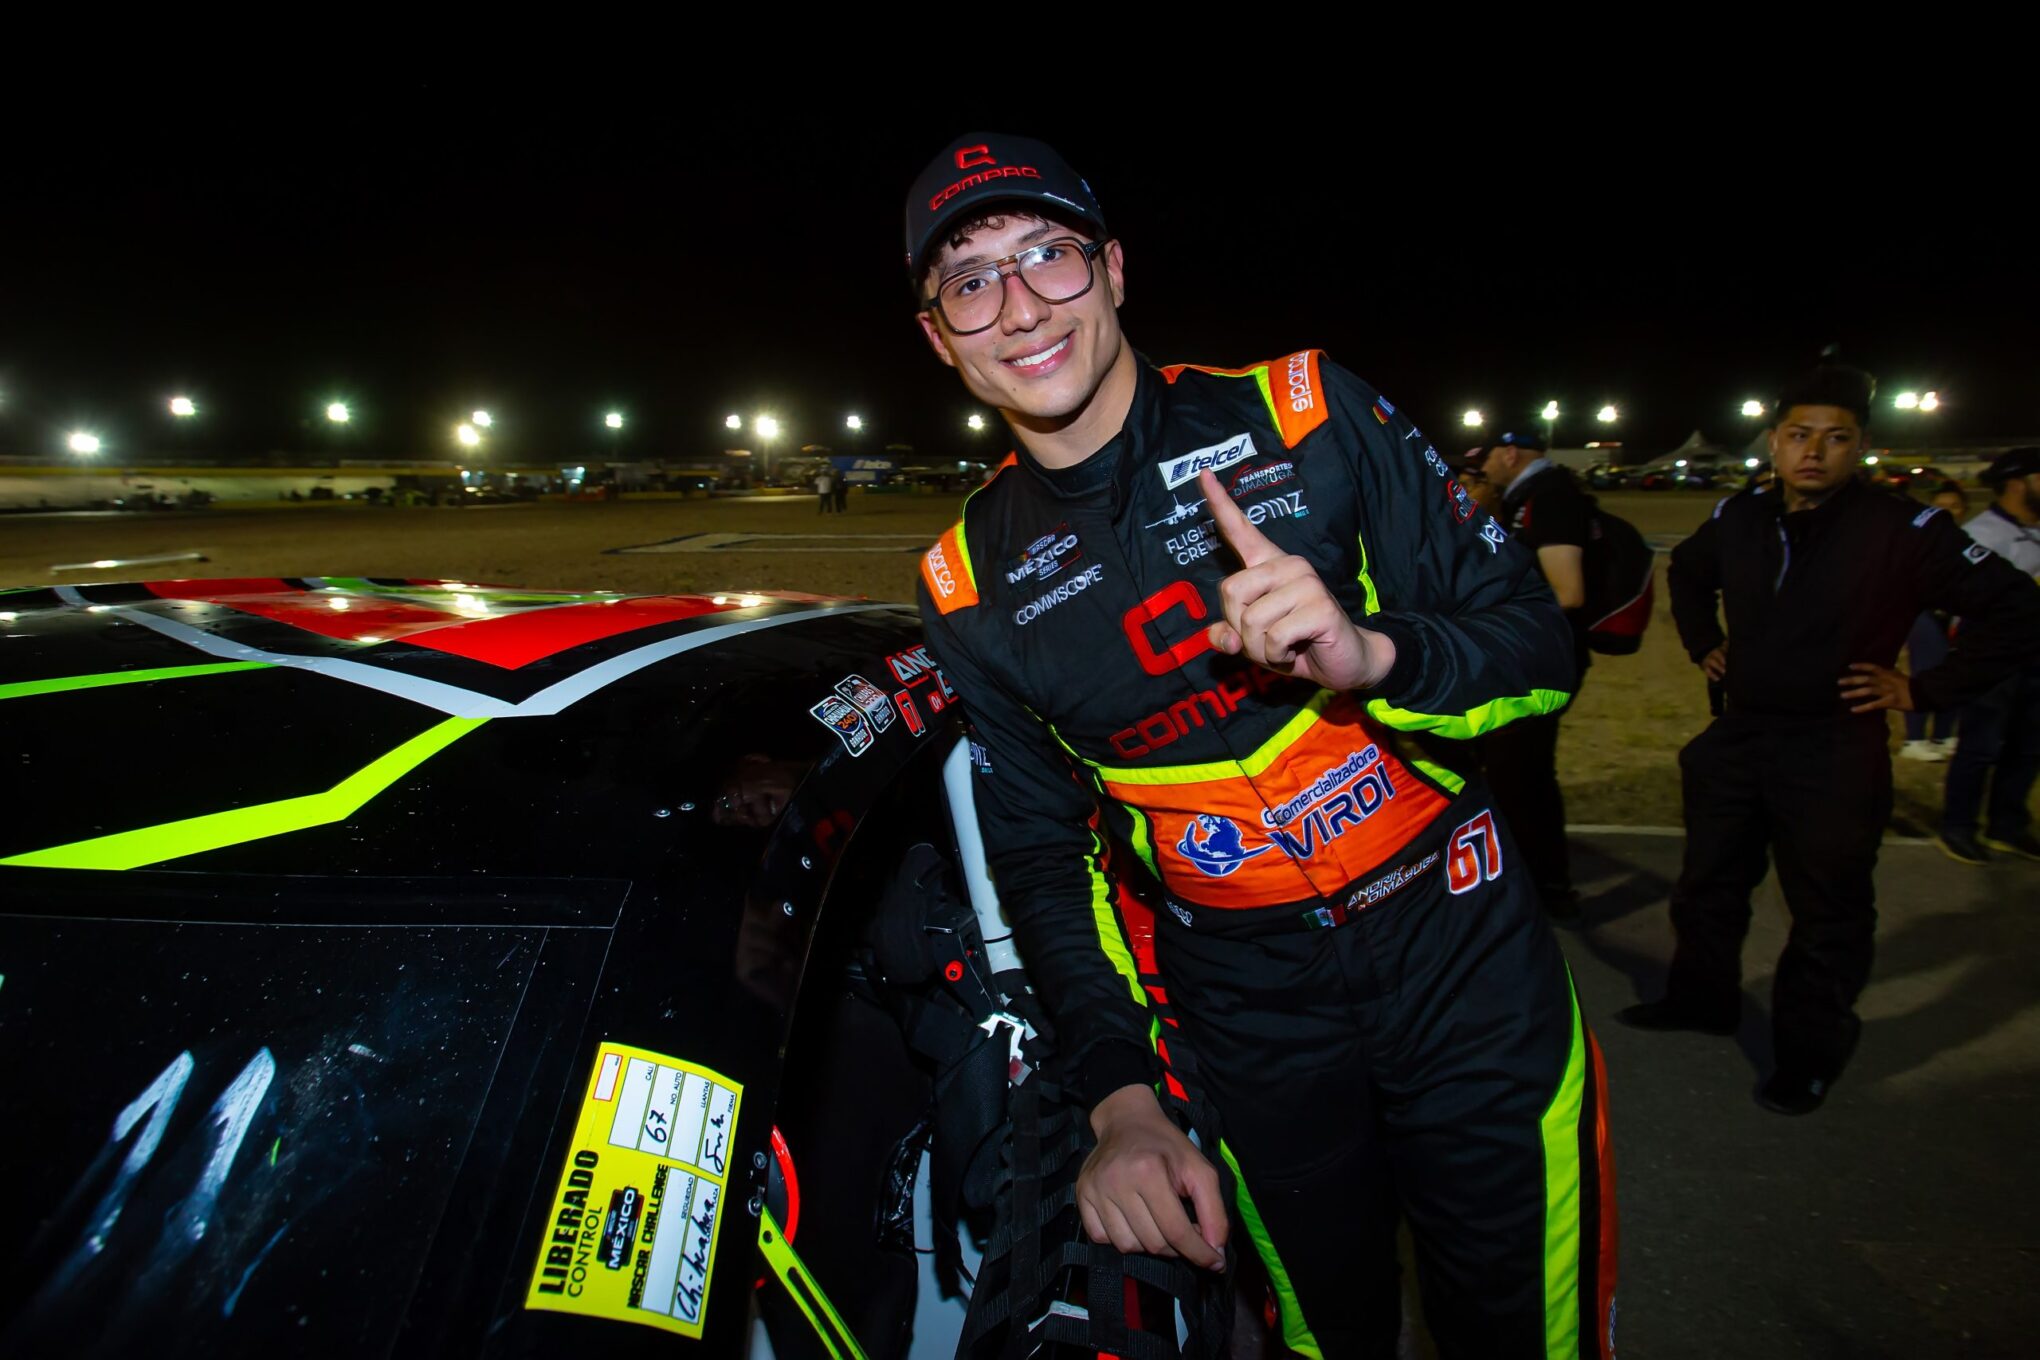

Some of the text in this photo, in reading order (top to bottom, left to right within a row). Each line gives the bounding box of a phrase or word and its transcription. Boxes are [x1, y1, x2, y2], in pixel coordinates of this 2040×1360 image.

[1190, 438, 1247, 474] telcel
[1239, 462, 1293, 485] TRANSPORTES
[1166, 519, 1215, 554] FLIGHT
[1177, 537, 1221, 566] CREW
[1015, 566, 1103, 625] COMMSCOPE
[837, 713, 857, 729] 240
[1265, 761, 1396, 859] VIRDI
[1447, 808, 1503, 895] 67
[674, 1072, 682, 1091] AUTO
[700, 1081, 710, 1108] LLANTAS
[645, 1110, 667, 1143] 67
[681, 1177, 694, 1220] SEGURIDAD
[538, 1150, 599, 1295] LIBERADO
[627, 1164, 669, 1309] NASCAR CHALLENGE
[568, 1206, 603, 1298] CONTROL
